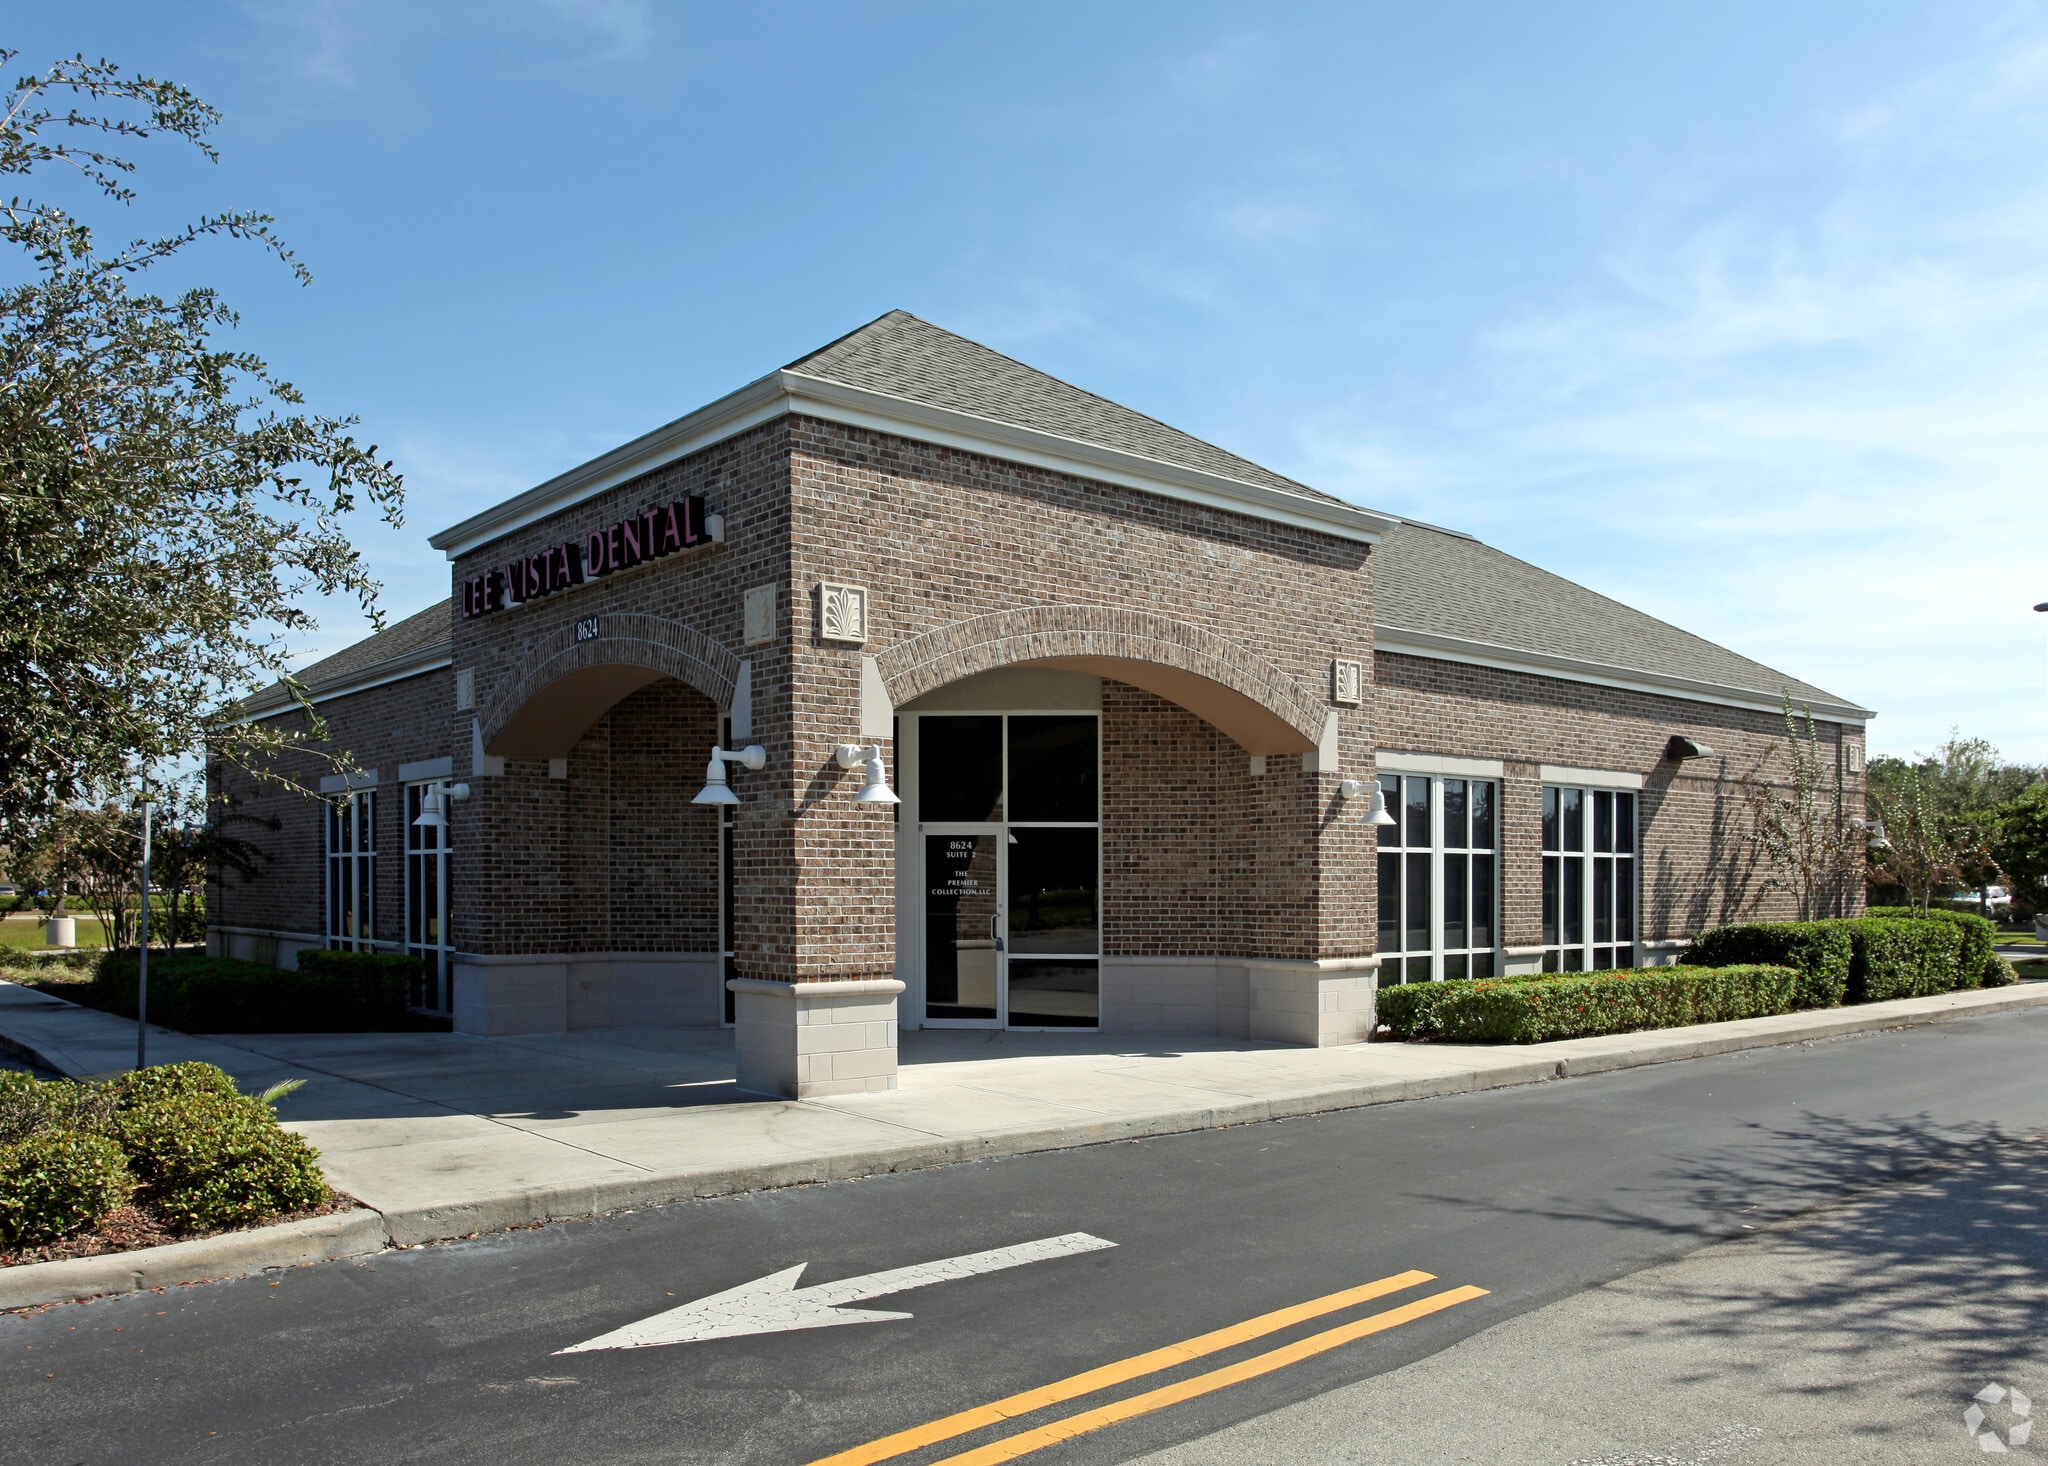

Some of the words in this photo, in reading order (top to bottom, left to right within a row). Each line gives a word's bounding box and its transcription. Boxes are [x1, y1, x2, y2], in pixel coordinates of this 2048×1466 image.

[462, 572, 492, 618] LEE
[506, 543, 571, 600] VISTA
[587, 496, 698, 577] DENTAL
[577, 617, 598, 641] 8624
[950, 841, 972, 850] 8624
